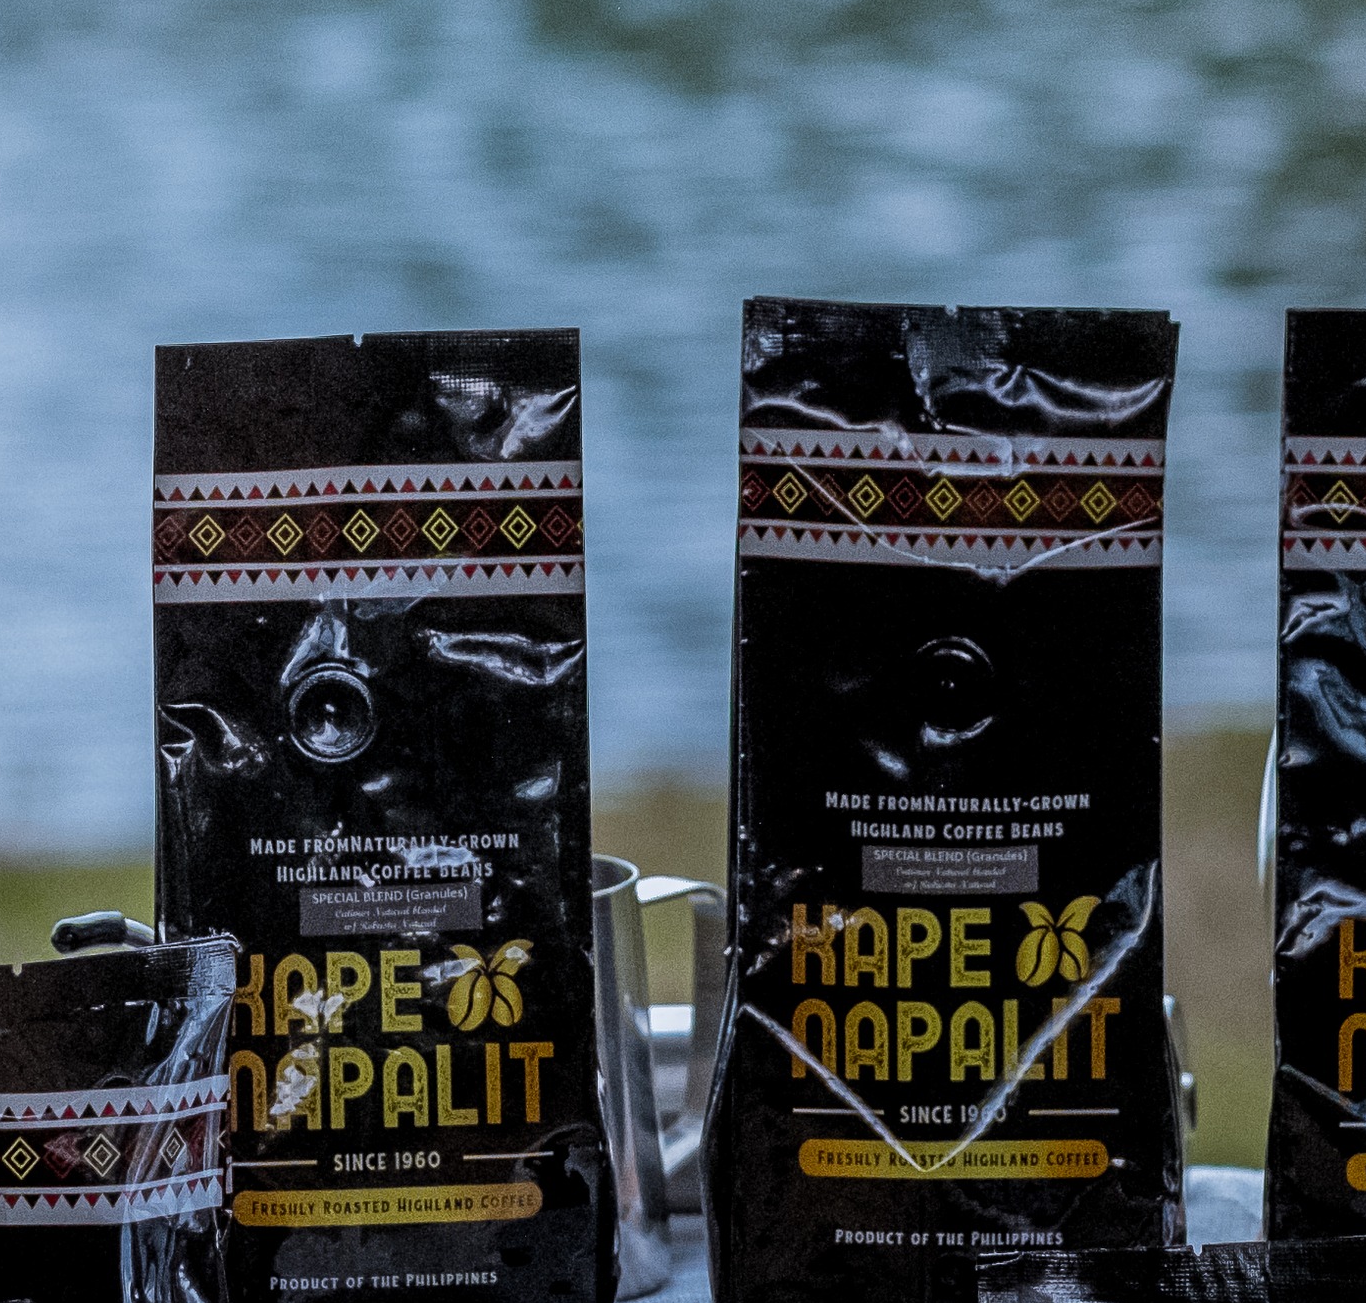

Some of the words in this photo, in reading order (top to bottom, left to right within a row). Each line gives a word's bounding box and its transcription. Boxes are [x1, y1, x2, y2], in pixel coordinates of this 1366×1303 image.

[826, 791, 870, 810] MADE
[851, 820, 935, 839] HIGHLAND
[943, 824, 1003, 840] COFFEE
[1011, 822, 1064, 838] BEANS
[251, 838, 295, 855] MADE
[874, 850, 920, 861] SPECIAL
[277, 865, 363, 882] HIGHLAND
[371, 863, 432, 879] COFFEE
[312, 892, 360, 904] SPECIAL
[363, 890, 402, 902] BLEND
[407, 887, 468, 901] (Granules)
[791, 903, 992, 989] KAPE
[233, 949, 423, 1036] KAPE
[791, 997, 1121, 1083] NAPALIT
[230, 1041, 554, 1133] NAPALIT
[900, 1106, 952, 1124] SINCE
[334, 1153, 386, 1171] SINCE
[394, 1151, 441, 1169] 1960
[817, 1150, 880, 1166] FRESHLY
[964, 1152, 1038, 1167] HIGHLAND
[1046, 1150, 1098, 1166] COFFEE
[252, 1201, 314, 1216] FRESHLY
[324, 1200, 390, 1215] ROASTED
[398, 1197, 473, 1212] HIGHLAND
[835, 1230, 903, 1245] PRODUCT
[911, 1232, 929, 1245] OF
[936, 1232, 964, 1245] THE
[971, 1230, 1064, 1245] PHILIPPINES
[270, 1276, 339, 1291] PRODUCT
[346, 1276, 363, 1289] OF
[371, 1275, 398, 1288] THE
[406, 1272, 497, 1287] PHILIPPINES
